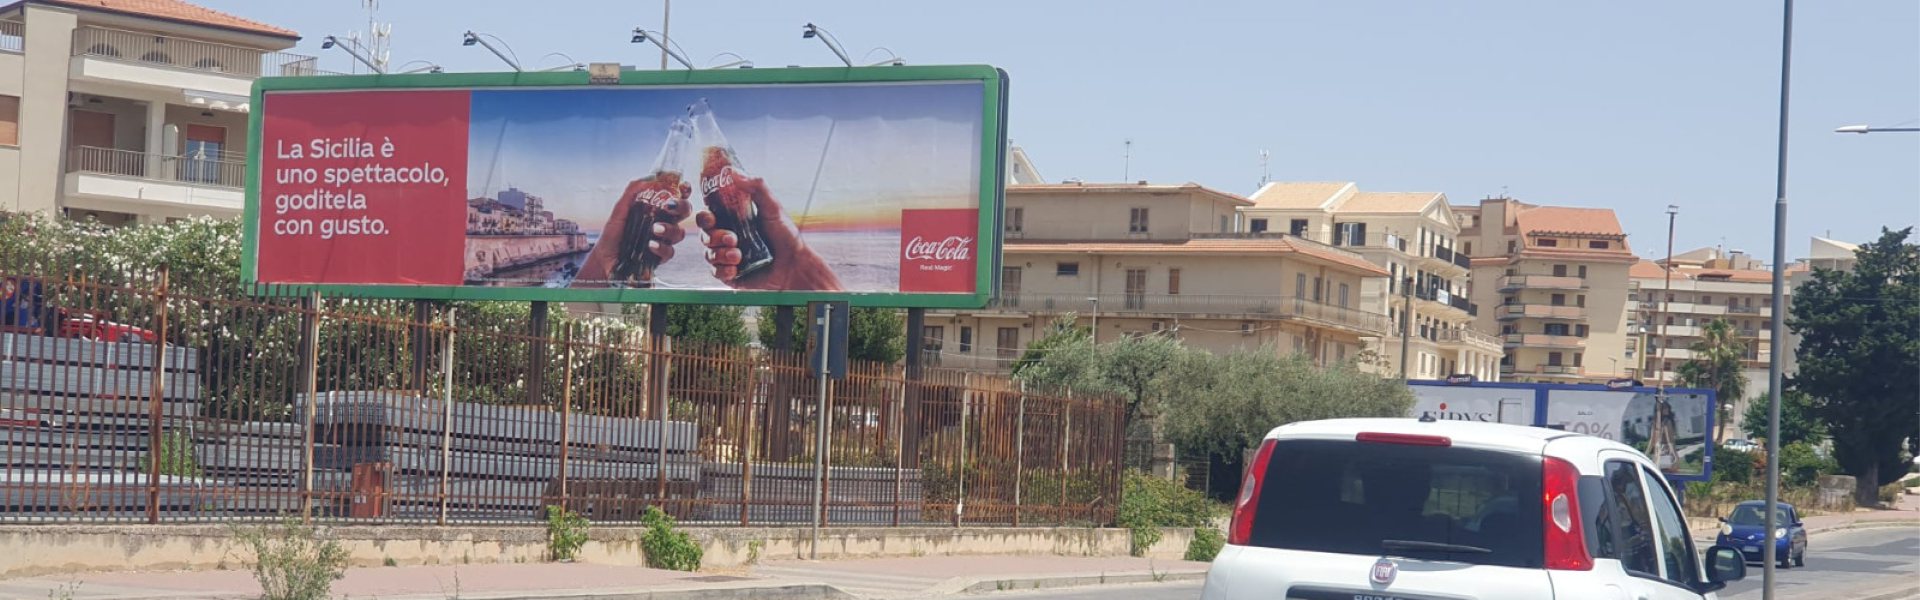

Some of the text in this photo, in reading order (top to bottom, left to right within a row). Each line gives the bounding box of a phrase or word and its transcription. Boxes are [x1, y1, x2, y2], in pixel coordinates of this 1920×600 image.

[277, 136, 395, 158] La Sicilia è
[276, 163, 450, 188] uno spettacolo,
[275, 189, 367, 215] goditela
[274, 215, 390, 240] con gusto.
[905, 235, 973, 260] Coca-Cola
